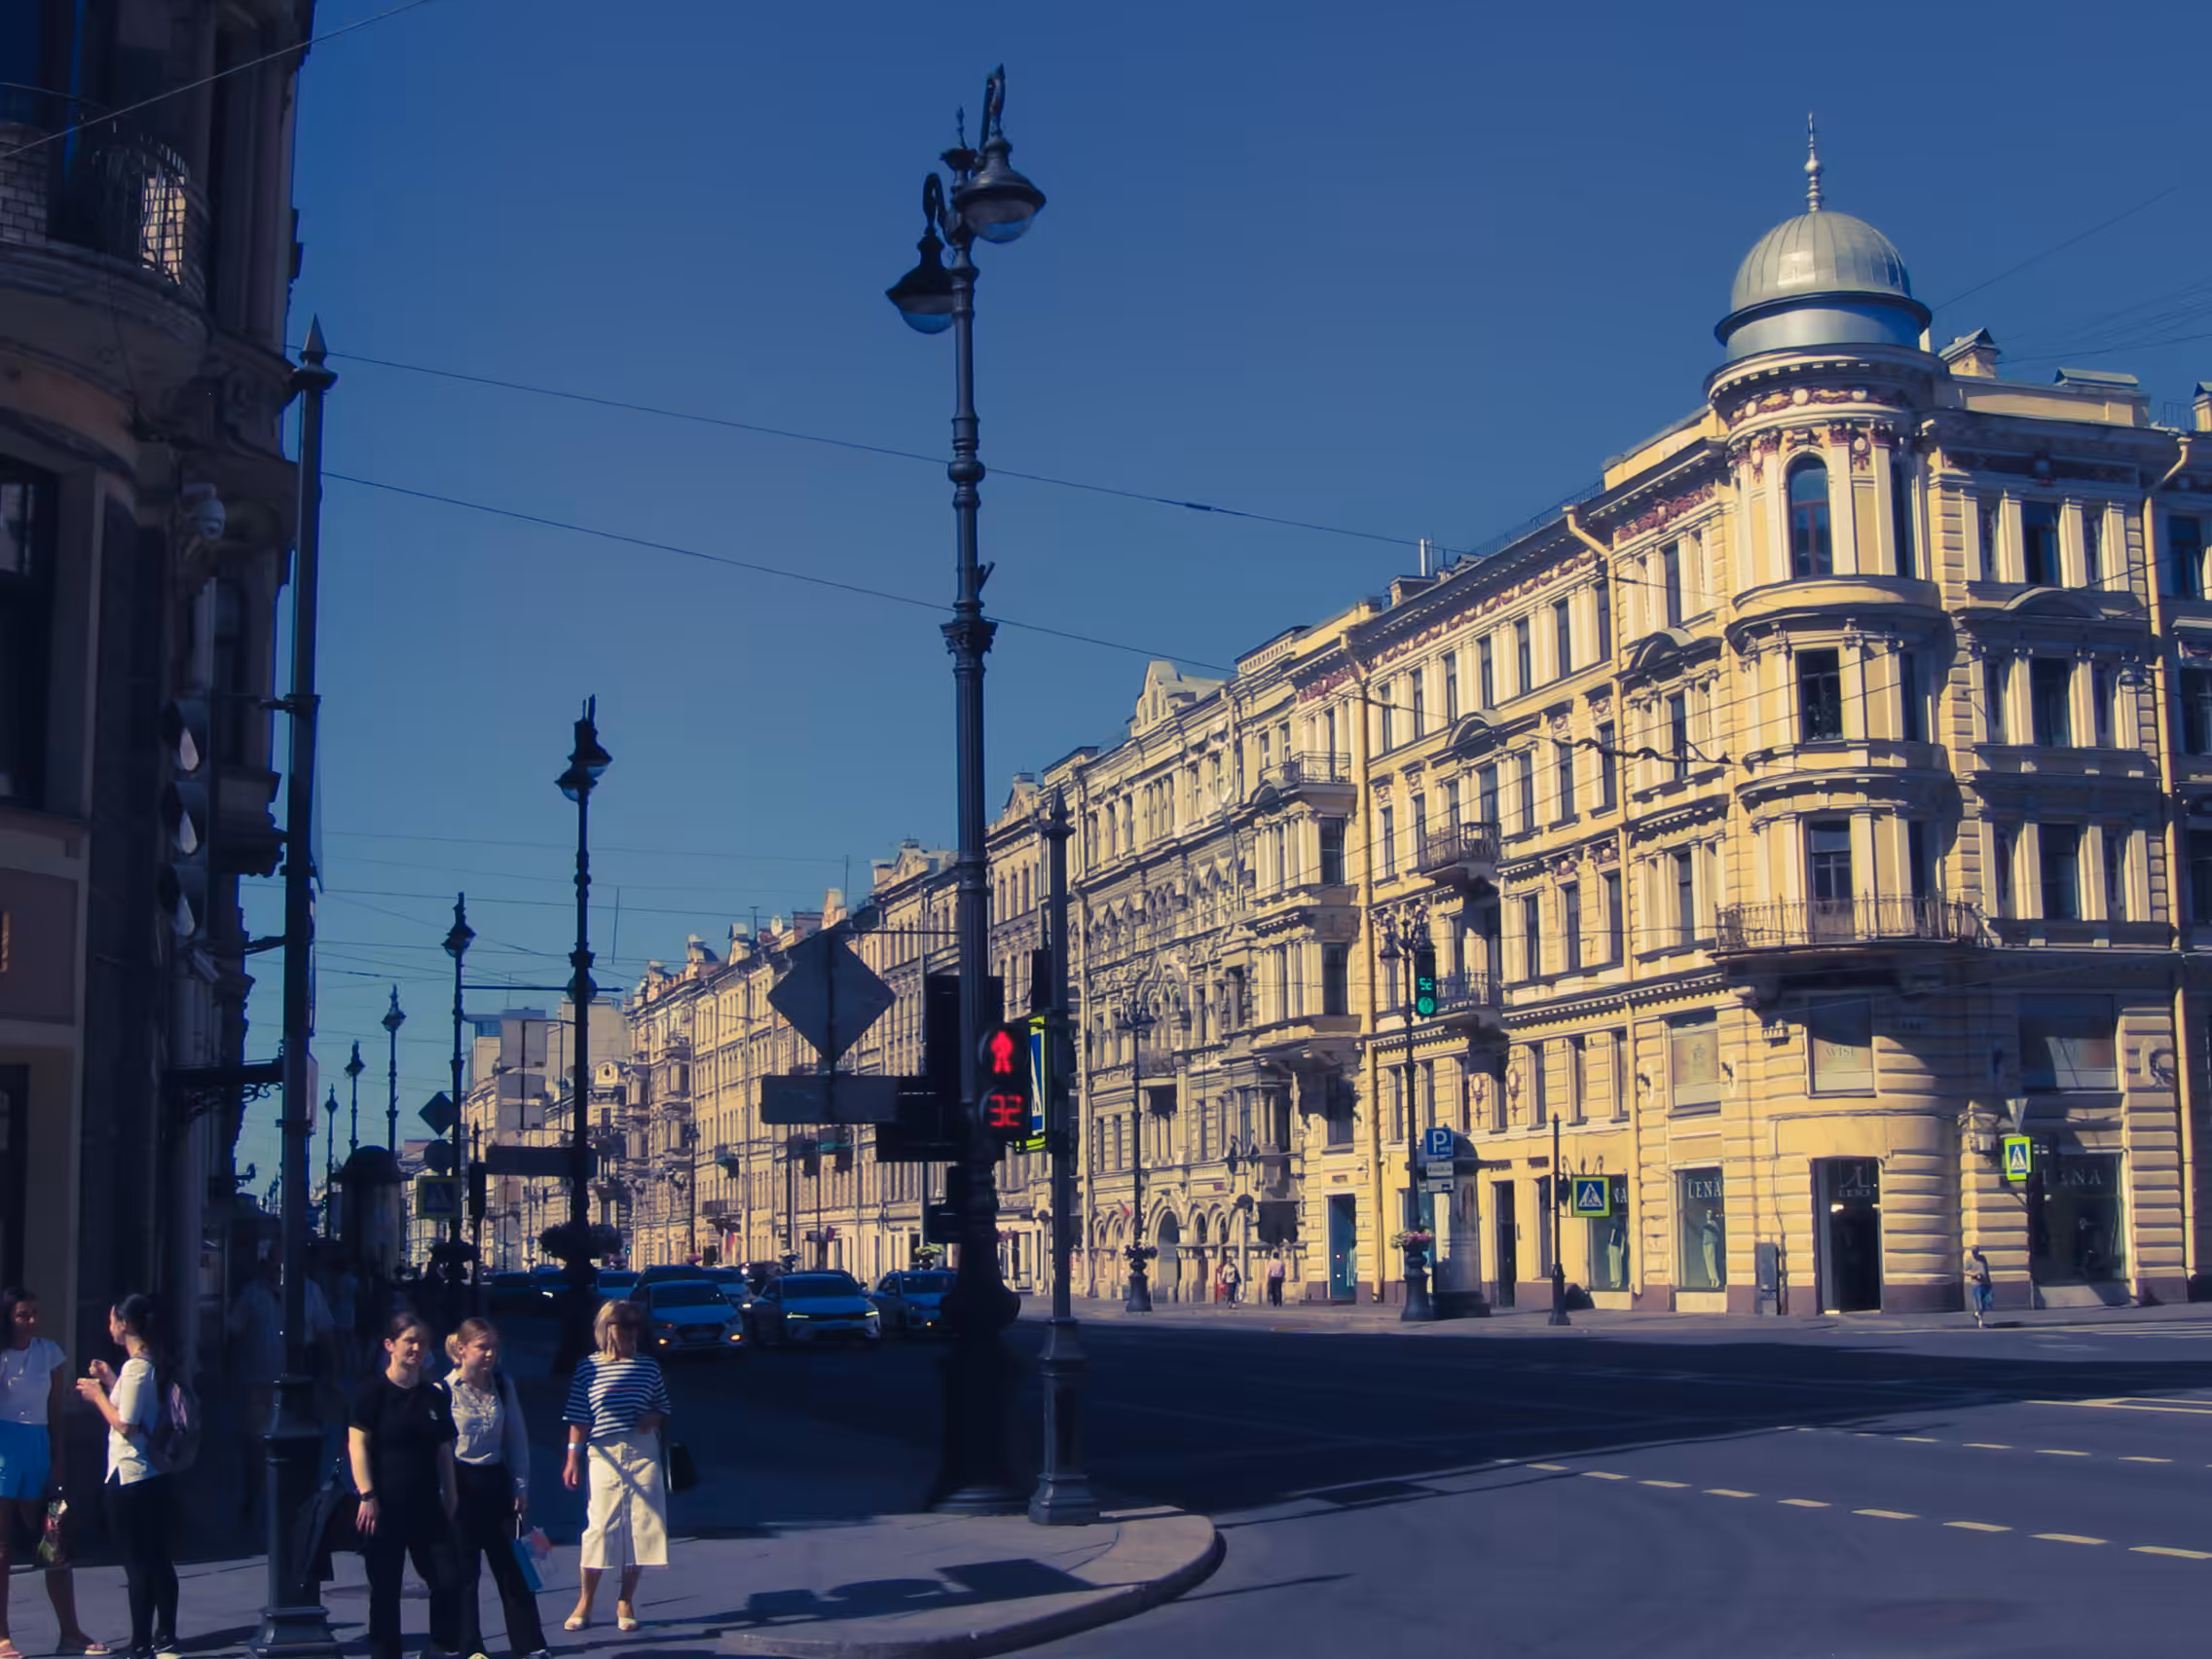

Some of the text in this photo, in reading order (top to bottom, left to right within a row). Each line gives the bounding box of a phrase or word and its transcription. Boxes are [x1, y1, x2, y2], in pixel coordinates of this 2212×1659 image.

[989, 1093, 1022, 1127] 32
[1433, 1130, 1447, 1154] P
[1688, 1180, 1722, 1198] LENA
